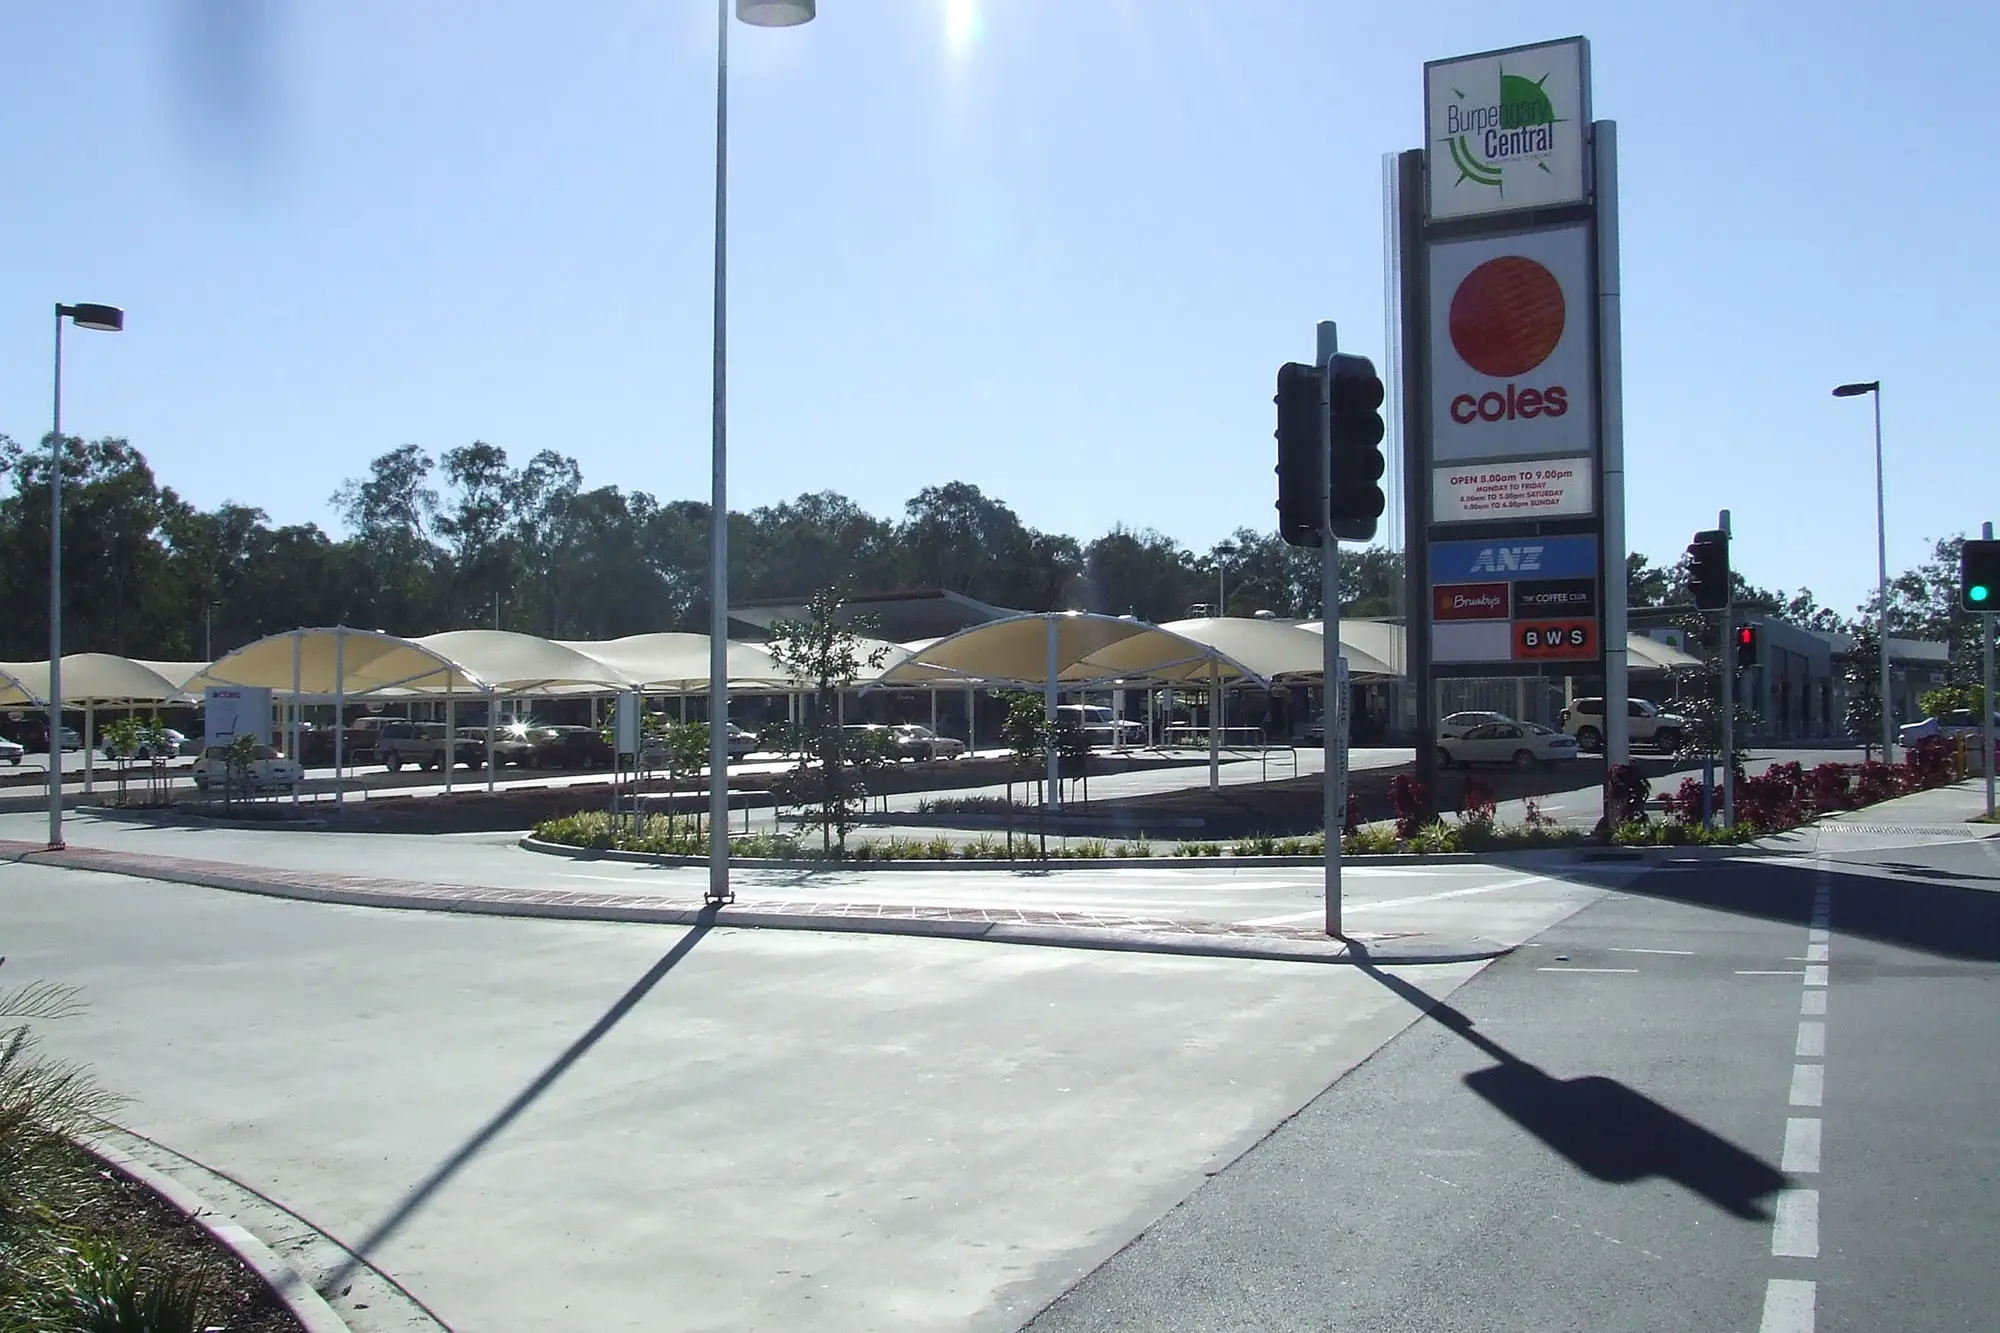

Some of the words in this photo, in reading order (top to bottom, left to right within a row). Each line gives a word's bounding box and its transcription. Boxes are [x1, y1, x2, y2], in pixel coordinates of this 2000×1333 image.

[1485, 123, 1553, 158] Central
[1451, 384, 1568, 424] coles
[1450, 475, 1478, 485] OPEN
[1480, 474, 1517, 484] 8.00am
[1519, 472, 1532, 480] TO
[1535, 470, 1573, 480] 9.00pm
[1476, 484, 1508, 492] MONDAY
[1521, 482, 1547, 490] FRIDAY
[1526, 490, 1564, 498] SATURDAY
[1470, 546, 1544, 573] ANZ
[1453, 593, 1500, 609] Brumby's
[1535, 593, 1568, 603] COFFEE
[1569, 593, 1587, 601] CLUB
